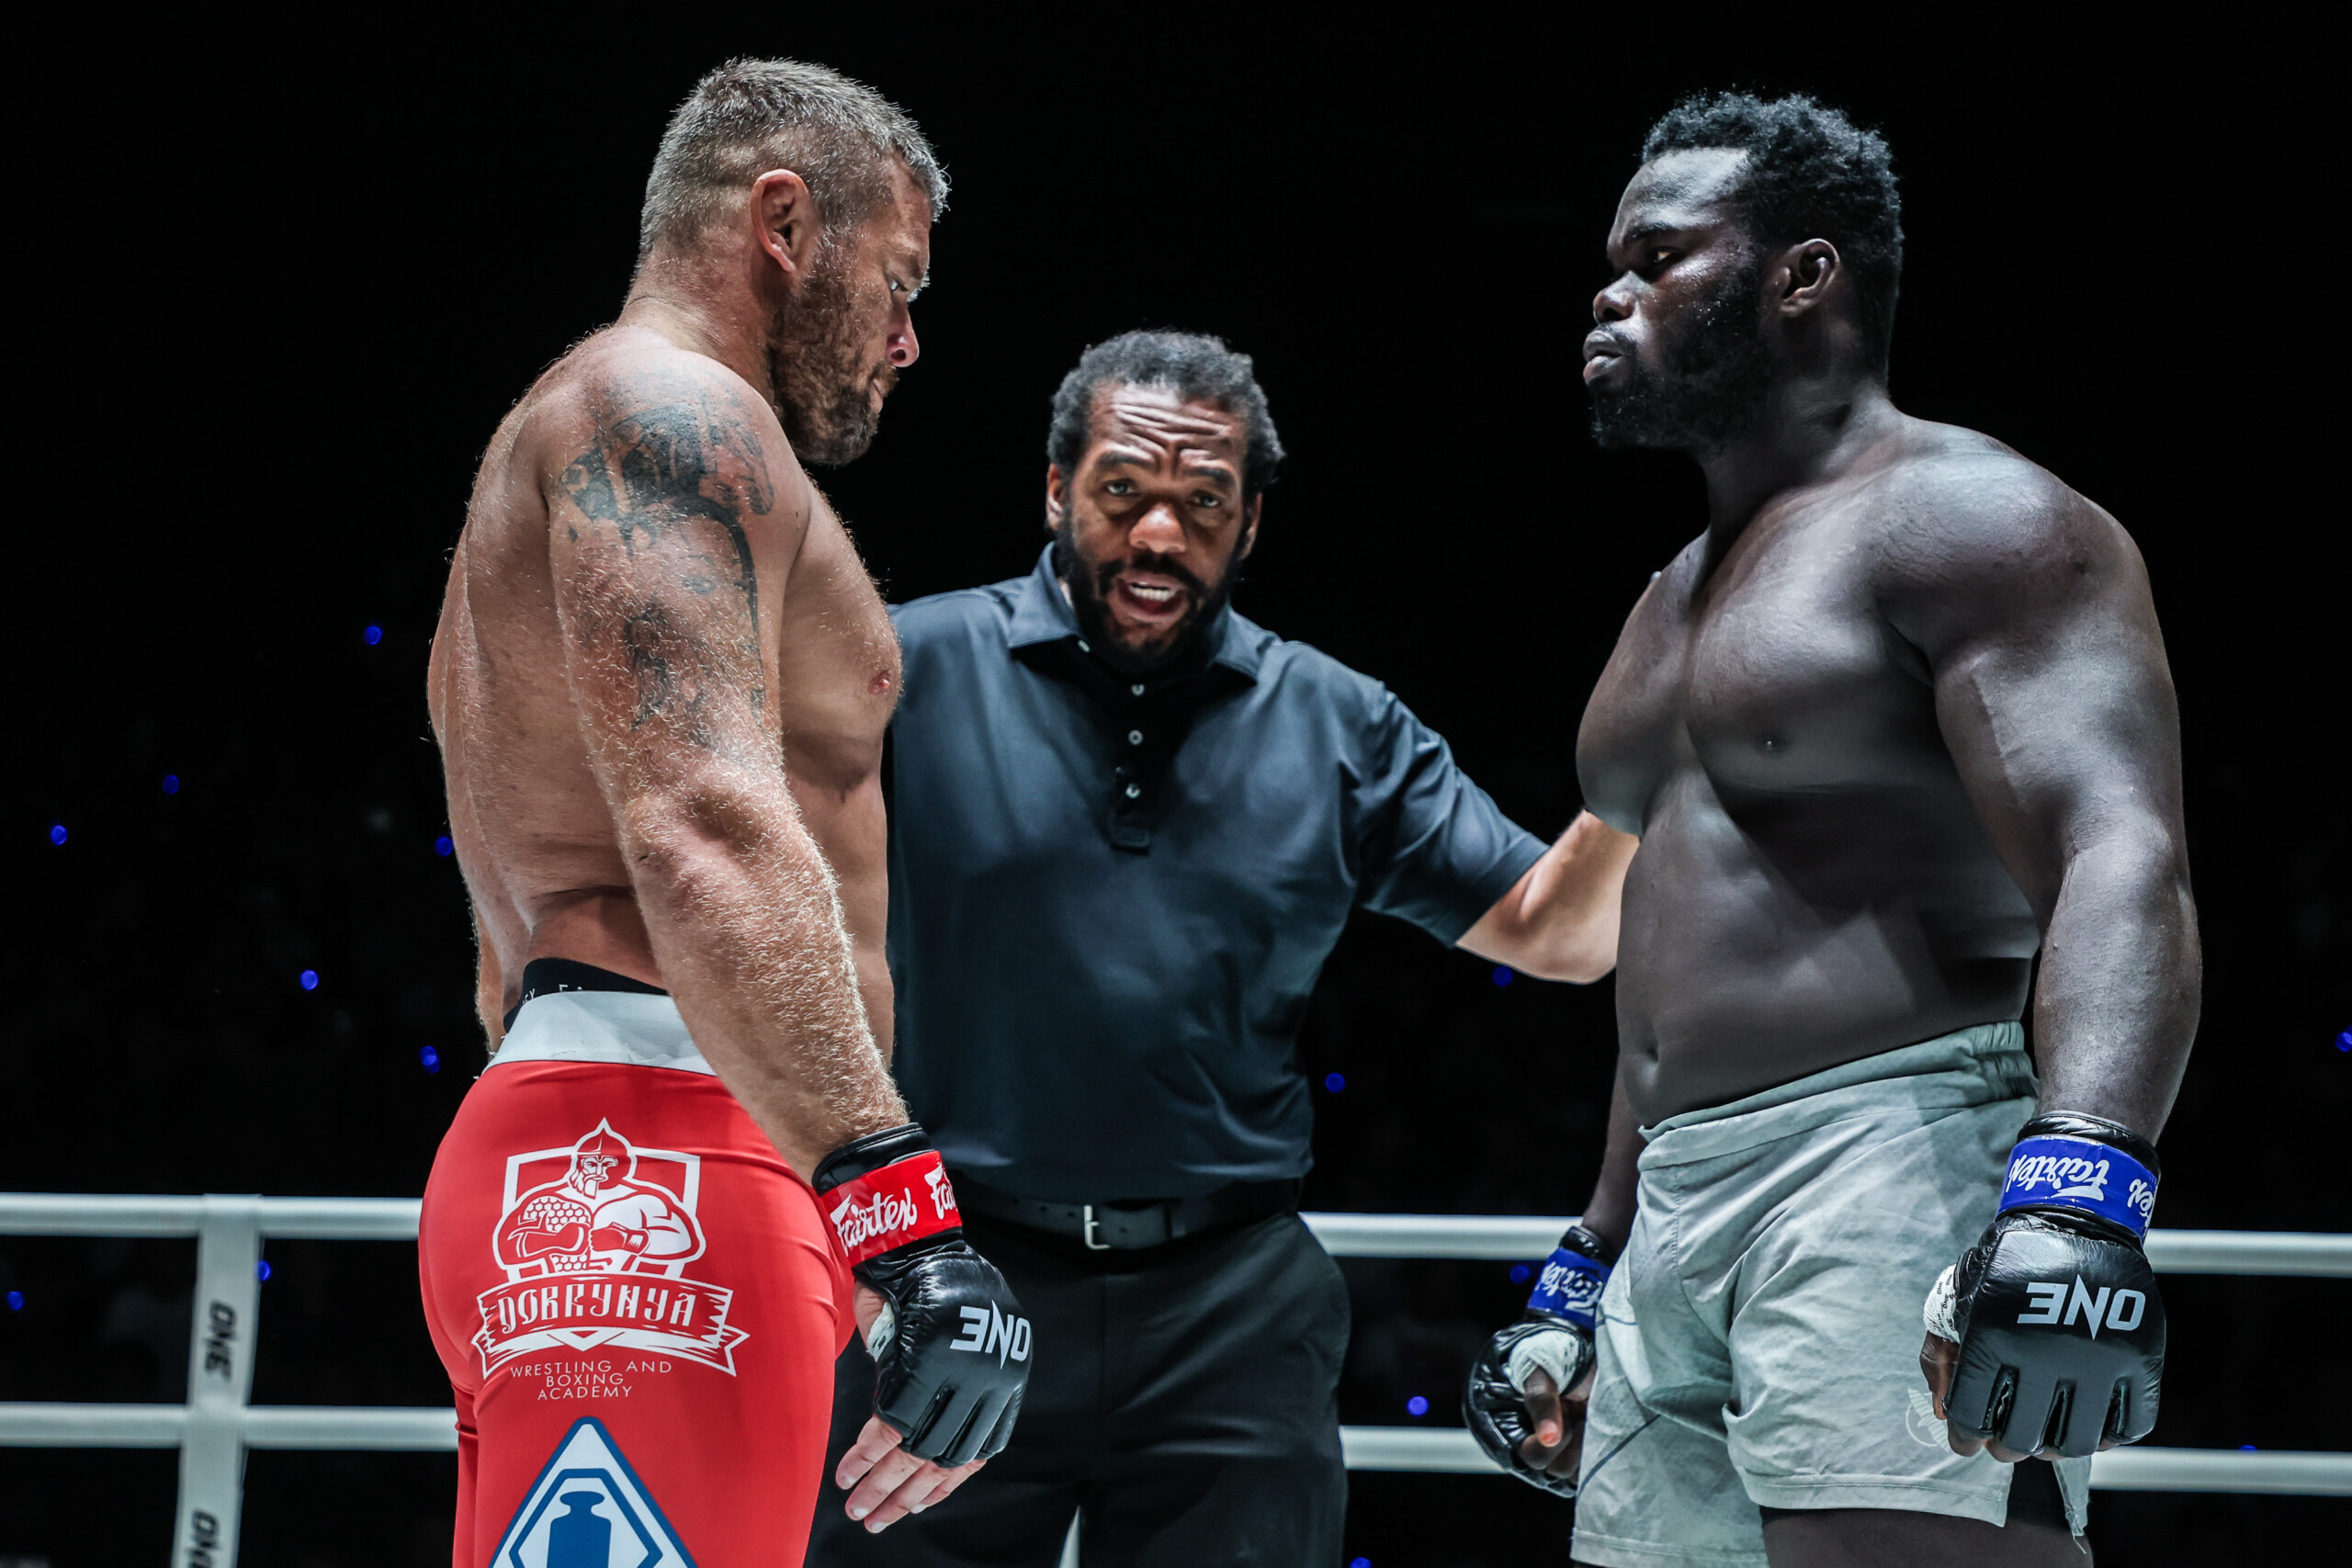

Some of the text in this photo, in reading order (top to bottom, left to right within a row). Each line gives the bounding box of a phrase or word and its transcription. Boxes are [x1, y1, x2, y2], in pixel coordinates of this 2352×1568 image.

[2005, 1155, 2110, 1201] Fairtex
[830, 1187, 917, 1257] Fairtex
[496, 1283, 696, 1334] DOBRYNYA
[2017, 1274, 2146, 1340] ONE
[204, 1300, 236, 1380] ONE
[949, 1300, 1031, 1370] ONE
[510, 1359, 673, 1378] WRESTLING AND
[537, 1385, 633, 1402] ACADEMY
[546, 1372, 624, 1388] BOXING
